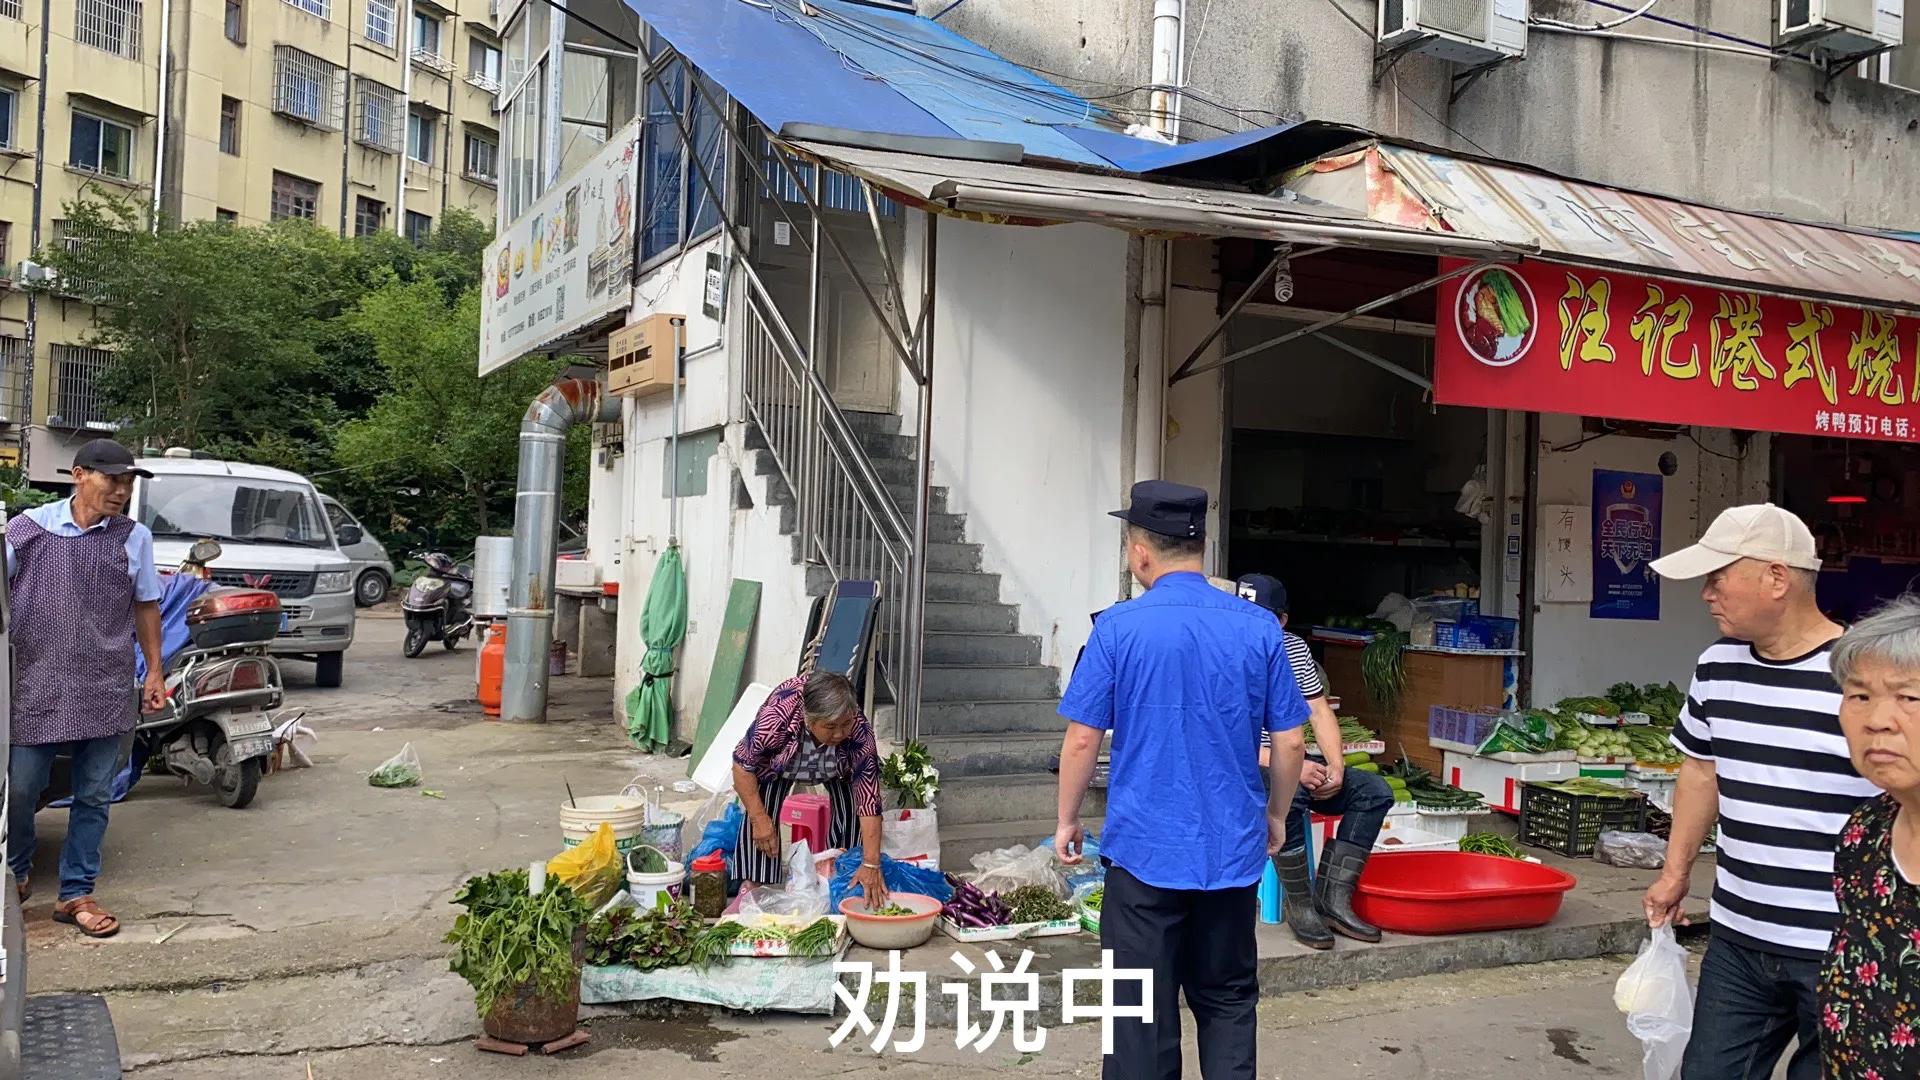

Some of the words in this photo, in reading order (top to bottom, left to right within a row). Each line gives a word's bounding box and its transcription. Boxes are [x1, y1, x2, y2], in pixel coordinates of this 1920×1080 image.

[1558, 272, 1920, 406] 汪记港式烧
[1601, 518, 1653, 539] 全民行动
